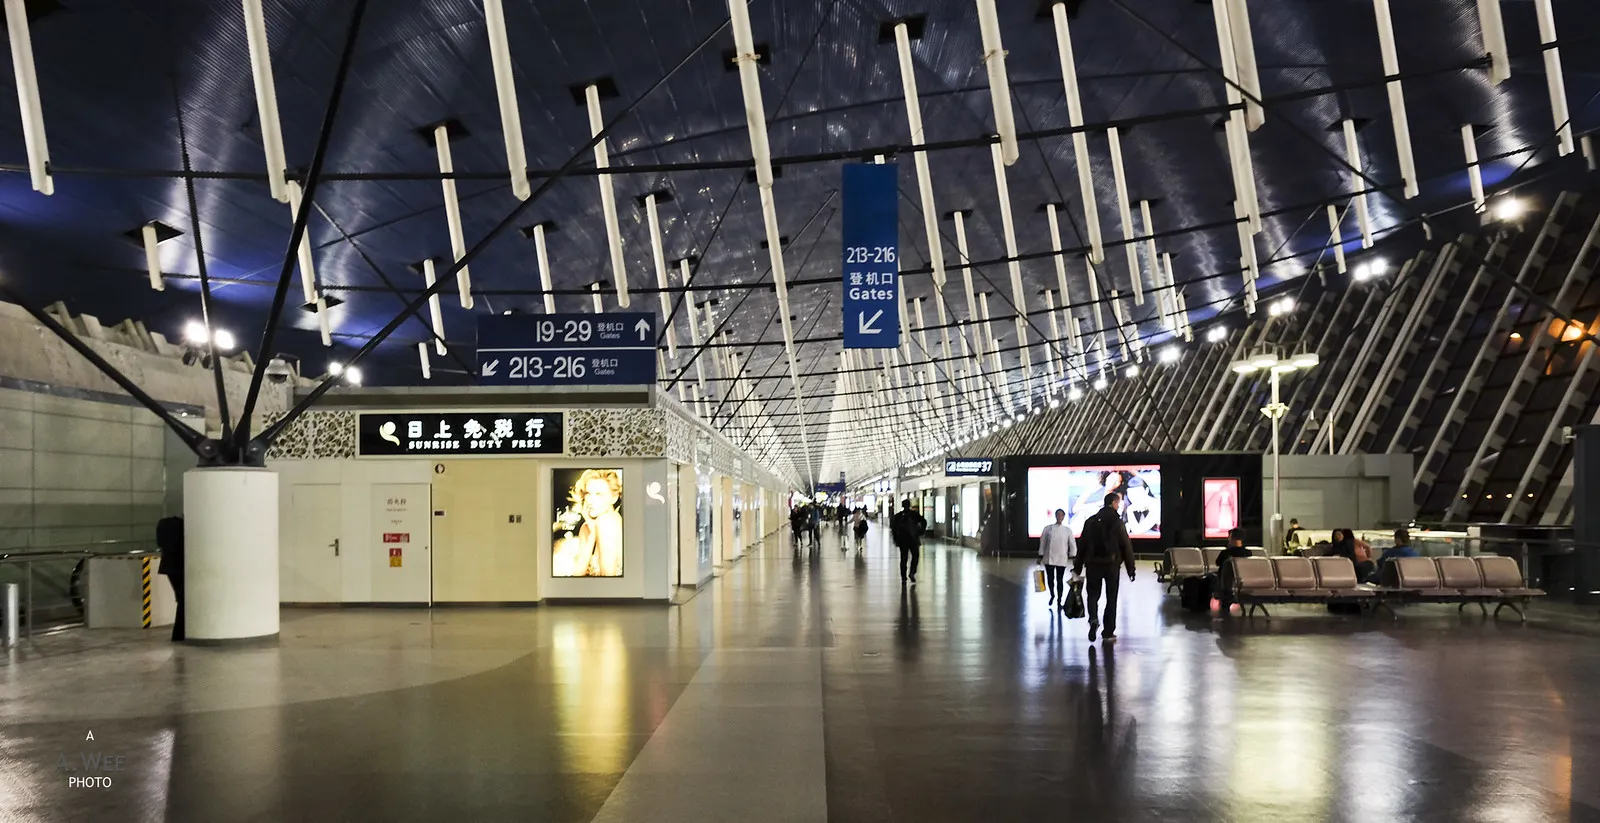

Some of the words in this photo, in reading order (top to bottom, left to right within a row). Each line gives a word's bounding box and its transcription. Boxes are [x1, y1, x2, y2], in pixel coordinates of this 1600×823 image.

[846, 247, 896, 263] 213-216
[850, 272, 893, 285] 登机口
[849, 288, 893, 300] Gates
[536, 320, 592, 342] 19-29
[597, 322, 624, 332] 登机口
[509, 356, 586, 378] 213-216
[592, 358, 618, 368] 登机口
[407, 418, 544, 439] 日上免税行
[408, 440, 460, 449] SUNRISE
[470, 440, 502, 449] DUTY
[511, 439, 542, 448] FREE
[981, 461, 992, 472] 37
